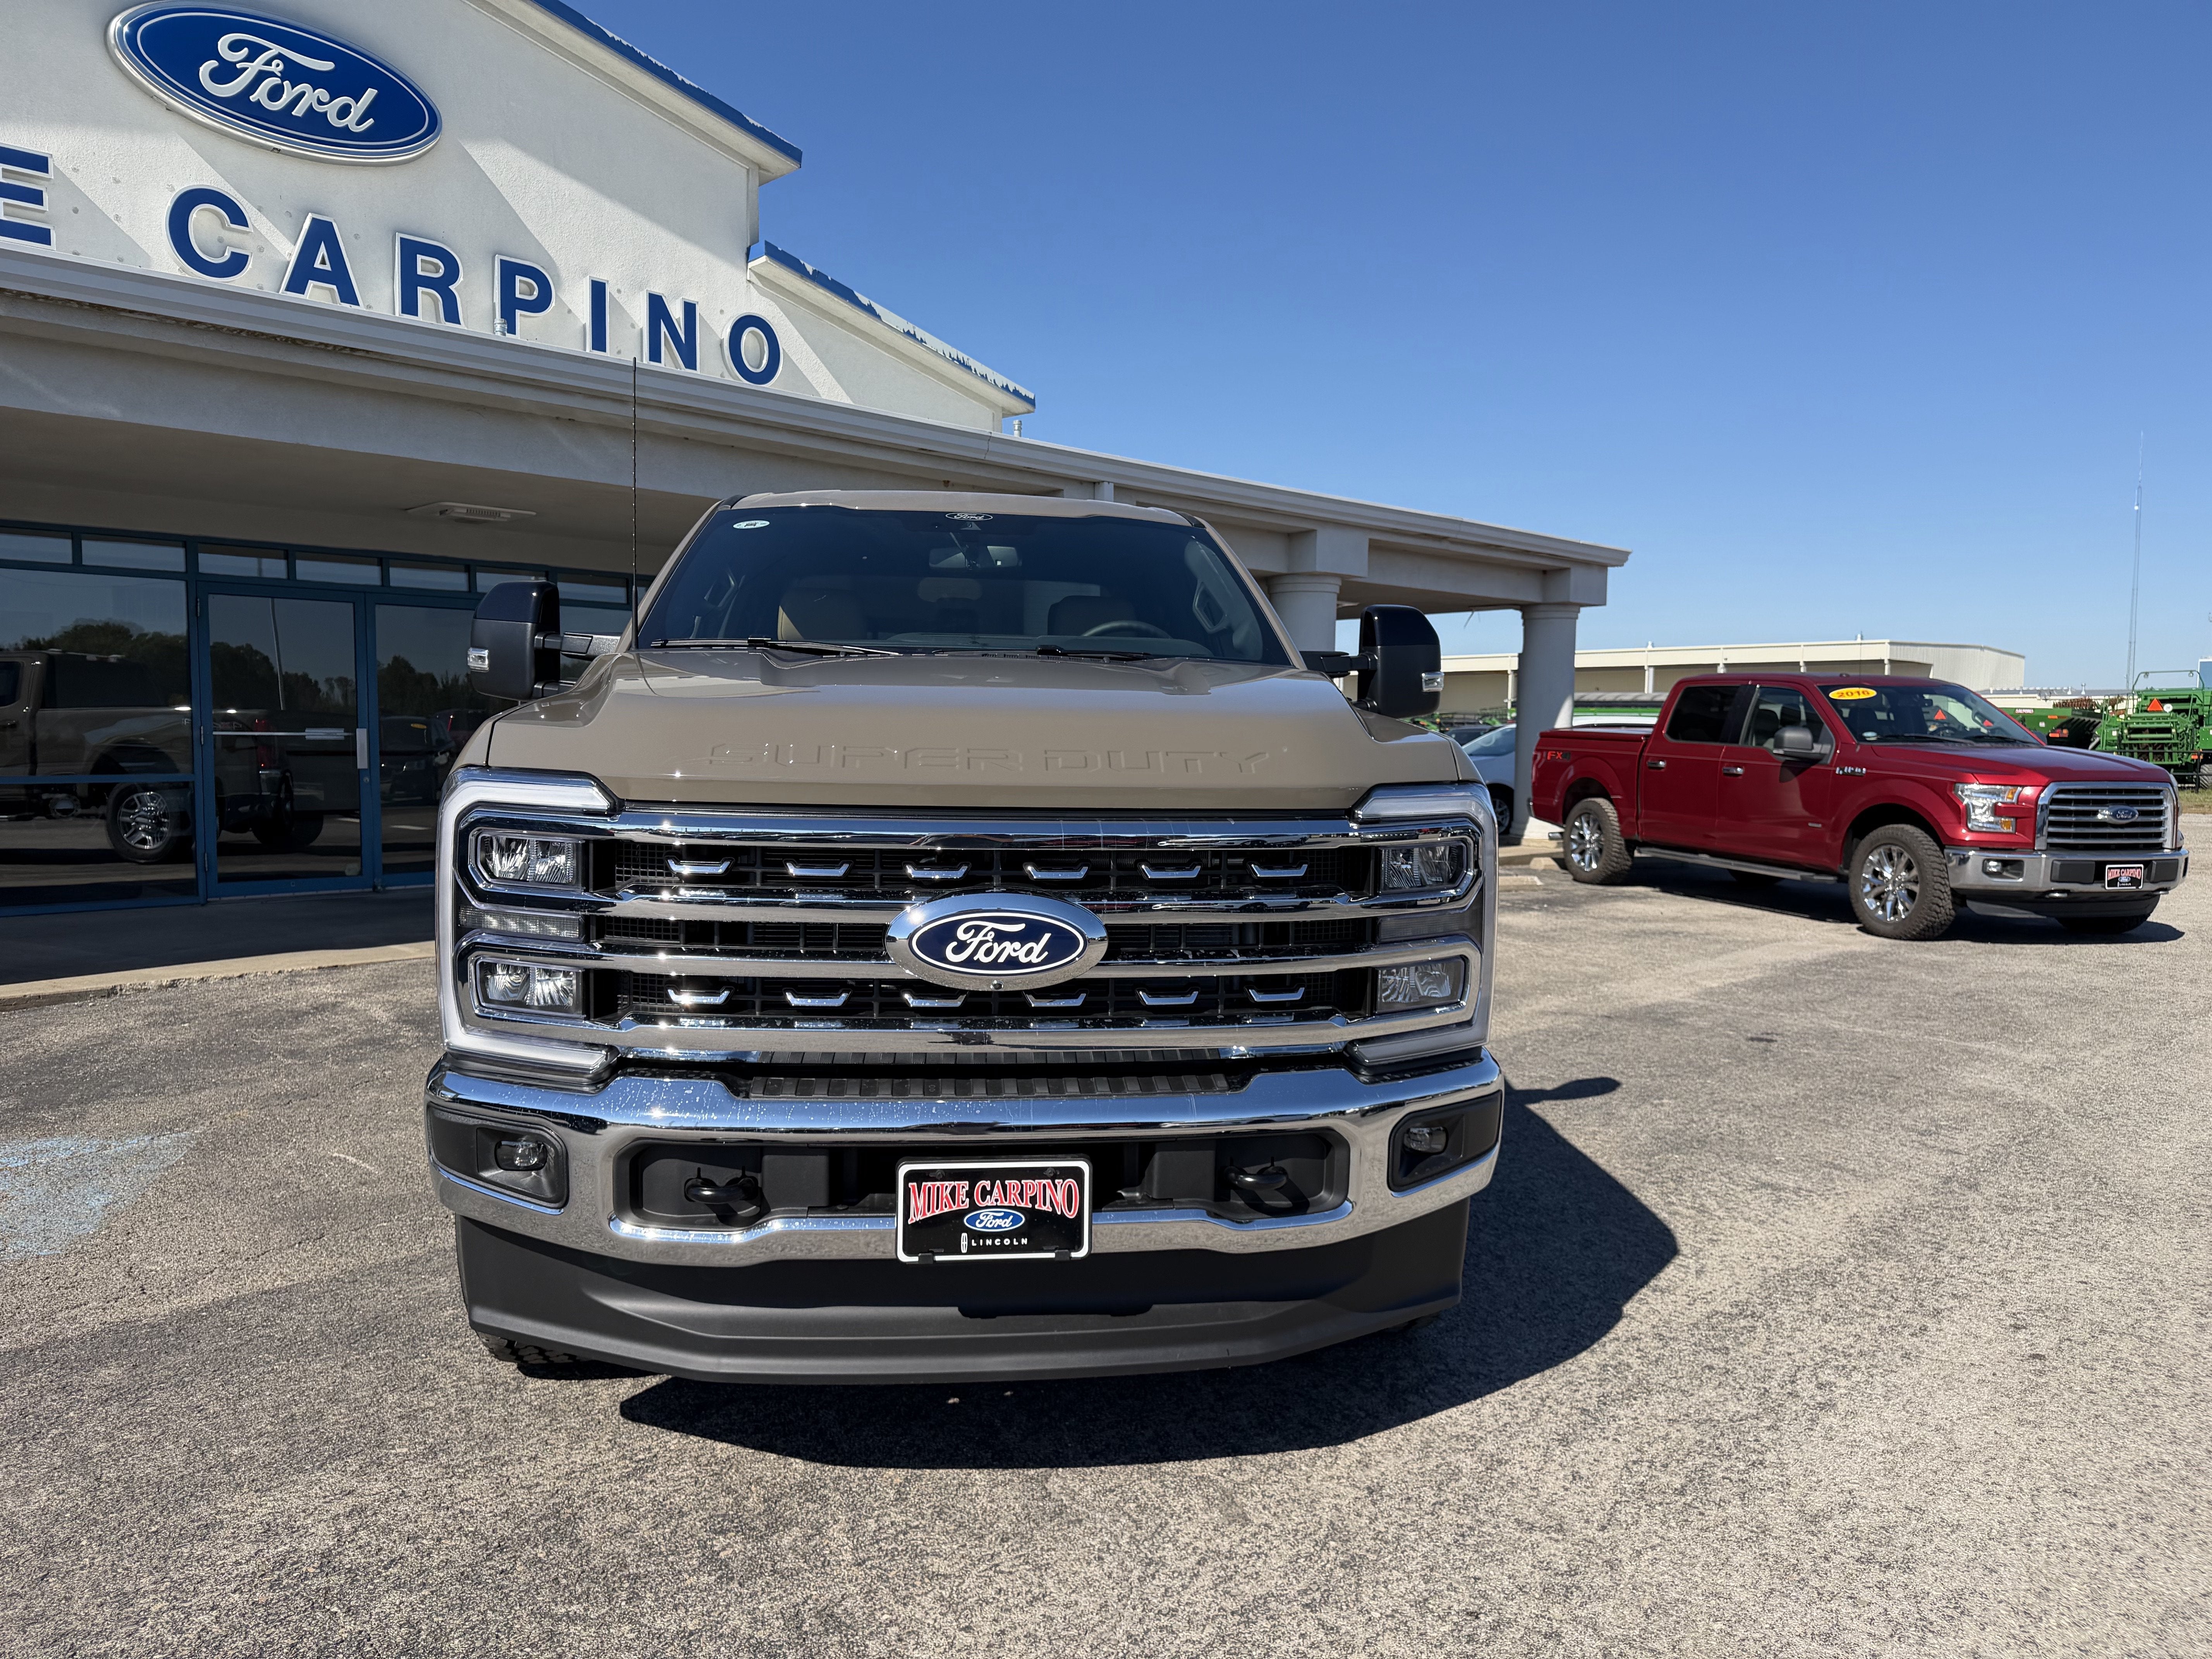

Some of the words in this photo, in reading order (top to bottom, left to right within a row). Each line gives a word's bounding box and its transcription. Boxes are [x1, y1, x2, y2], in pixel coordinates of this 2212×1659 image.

[199, 33, 378, 133] Ford
[165, 184, 783, 387] CARPINO
[709, 743, 1023, 771] SUPER
[1045, 750, 1269, 773] DUTY
[945, 920, 1051, 963] Ford
[908, 1181, 969, 1224] MIKE
[974, 1178, 1080, 1219] CARPINO
[975, 1212, 1012, 1228] Ford
[971, 1238, 1028, 1246] LINCOLN
